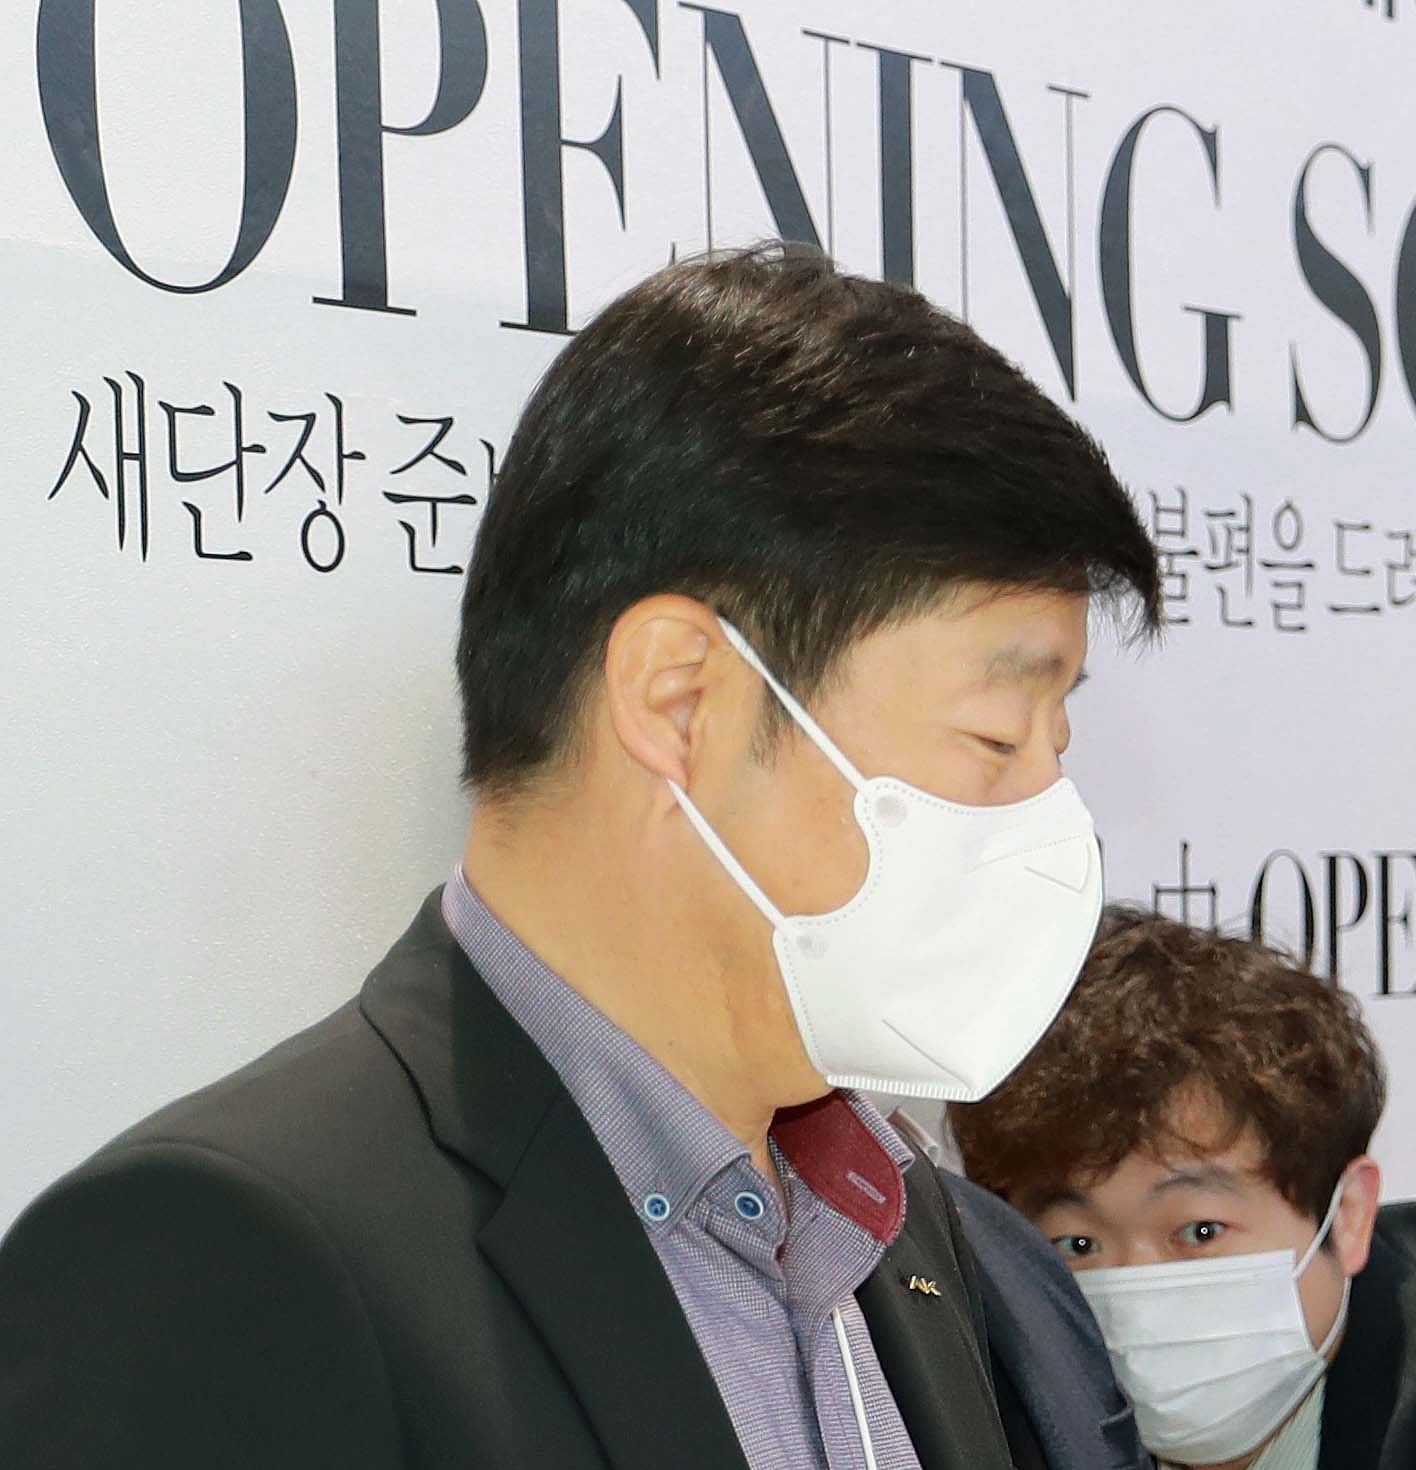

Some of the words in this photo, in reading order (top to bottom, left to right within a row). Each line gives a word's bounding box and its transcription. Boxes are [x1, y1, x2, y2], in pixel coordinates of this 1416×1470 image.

[36, 0, 1242, 424] OPENING
[48, 369, 366, 574] 새단장
[382, 413, 503, 575] 준
[1148, 486, 1316, 633] 불편을
